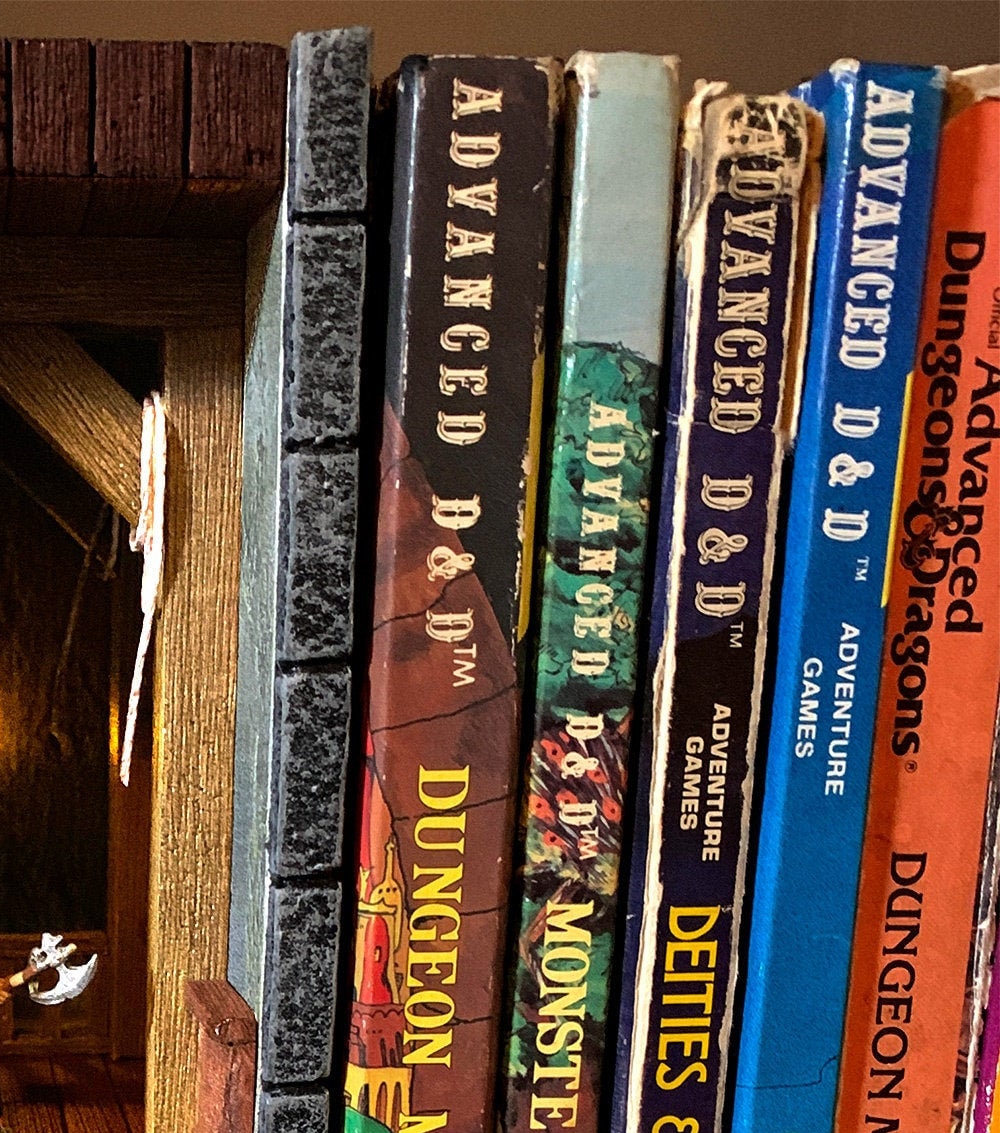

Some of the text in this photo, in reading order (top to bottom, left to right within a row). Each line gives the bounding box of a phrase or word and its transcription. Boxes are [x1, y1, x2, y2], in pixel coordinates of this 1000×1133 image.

[436, 77, 502, 446] ADVANCED
[710, 119, 786, 434] ADVANCED
[839, 80, 914, 370] ADVANCED
[918, 231, 986, 509] Dungeons
[945, 357, 1000, 633] Advanced
[572, 401, 625, 677] ADVANCED
[680, 736, 703, 830] GAMES
[702, 703, 732, 863] ADVENTURE
[795, 657, 823, 758] GAMES
[825, 622, 860, 796] ADVENTURE
[402, 765, 470, 1068] DUNGEON
[655, 905, 720, 1091] DEITIES
[866, 852, 927, 1100] DUNGEON
